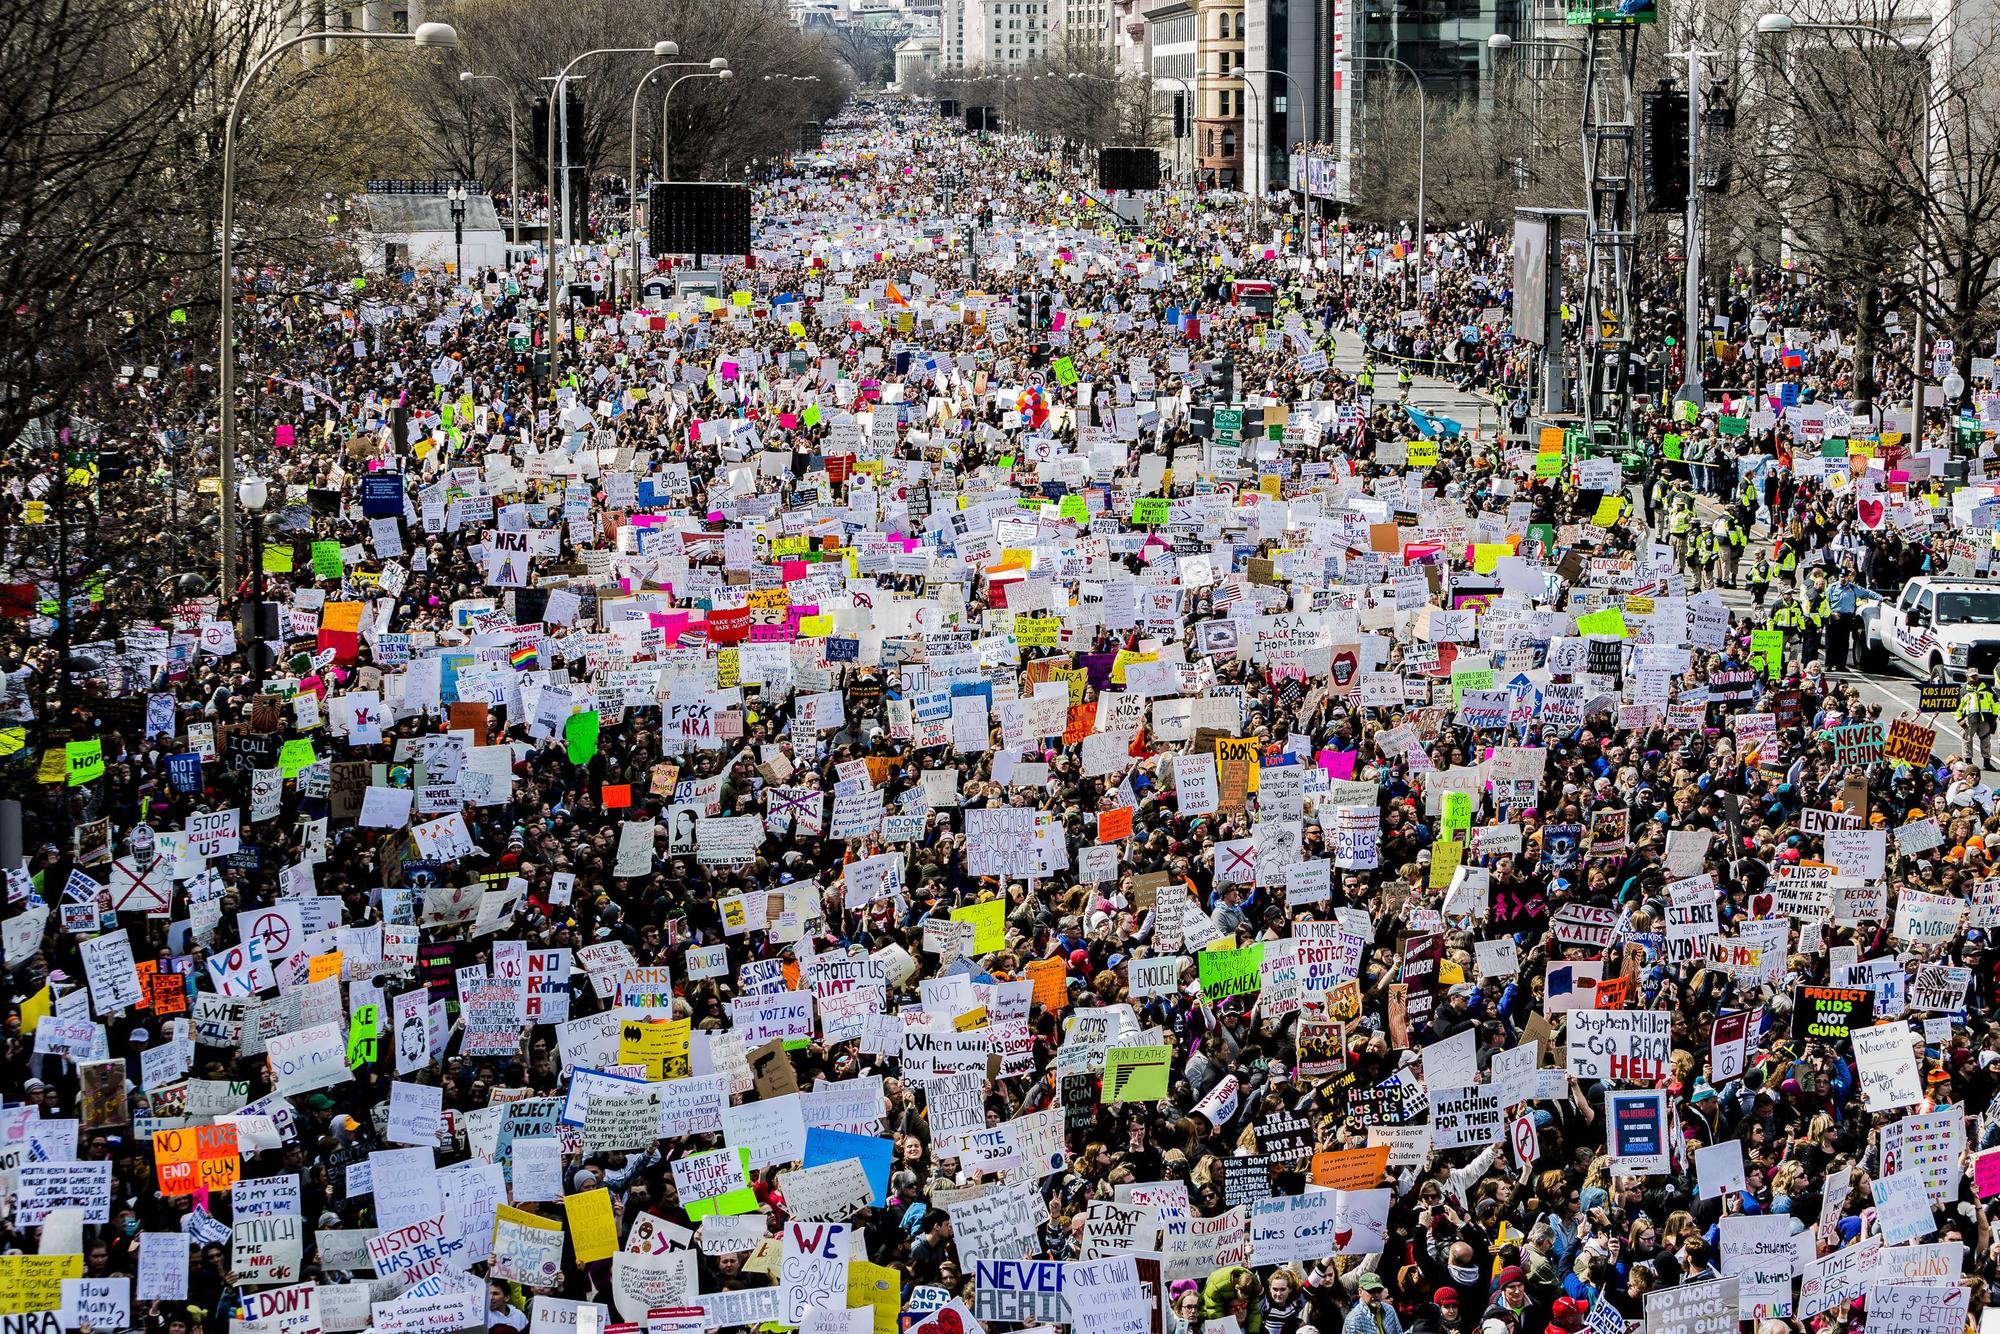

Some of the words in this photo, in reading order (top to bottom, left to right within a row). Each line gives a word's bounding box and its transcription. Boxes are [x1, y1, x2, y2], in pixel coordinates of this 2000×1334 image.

[875, 421, 893, 429] GUN
[872, 429, 895, 437] REFORM
[661, 477, 688, 488] GUNS
[671, 486, 688, 495] HUGS
[495, 532, 527, 552] NRA
[965, 550, 991, 563] GUNS
[293, 613, 316, 623] NEVER
[730, 620, 748, 629] AGAIN
[1274, 618, 1286, 627] AS
[1296, 616, 1304, 626] A
[292, 623, 315, 633] AGAIN
[1445, 622, 1458, 635] BS
[1259, 630, 1289, 640] BLACK
[1897, 627, 1919, 648] POLICE
[829, 639, 856, 649] NEVER
[979, 639, 1005, 653] NEVER
[1262, 641, 1287, 649] HOPE
[1405, 645, 1415, 653] WE
[1416, 643, 1437, 652] KNOW
[830, 649, 854, 659] AGAIN
[1923, 687, 1938, 695] KIDS
[1939, 686, 1958, 695] LIVES
[916, 696, 931, 705] END
[932, 693, 948, 703] GUN
[1922, 696, 1956, 707] MATTER
[918, 705, 949, 718] VIOLENCE
[1462, 707, 1502, 716] FUTURE
[1543, 703, 1582, 714] ASSAULT
[1465, 716, 1506, 726] VOTERS
[1544, 713, 1582, 724] WEAPON
[682, 718, 709, 736] NRA
[922, 724, 944, 732] KIDS
[1889, 720, 1936, 747] BROKEN
[921, 735, 948, 746] GUNS
[1836, 726, 1882, 745] NEVER
[242, 740, 268, 753] CALL
[1219, 741, 1259, 761] BOOKS
[1839, 745, 1883, 765] AGAIN
[170, 761, 194, 772] NOT
[236, 755, 254, 770] BS
[172, 773, 194, 783] ONE
[656, 768, 676, 778] books
[426, 790, 450, 798] NEVER
[433, 798, 458, 806] AGAIN
[192, 813, 231, 832] STOP
[901, 818, 922, 826] ONE
[1805, 812, 1860, 831] ENOUGH
[188, 828, 229, 842] KILLING
[1338, 833, 1375, 850] Policy
[200, 843, 219, 856] US
[1542, 863, 1557, 871] NOT
[1559, 862, 1576, 870] GUNS
[65, 905, 96, 916] PROTECT
[1669, 905, 1713, 925] SILENCE
[64, 921, 95, 929] STUDENTS
[1298, 946, 1343, 963] PROTECT
[1710, 943, 1726, 963] NO
[689, 953, 725, 970] ENOUGH
[1405, 959, 1433, 975] LOUDER!
[817, 960, 867, 980] PROTECT
[870, 959, 884, 978] US
[1272, 968, 1296, 983] LAWS
[1309, 963, 1332, 976] OUR
[624, 969, 668, 984] ARMS
[1138, 966, 1174, 988] ENOUGH
[624, 993, 668, 1008] HUGGING
[1804, 988, 1866, 1000] PROTECT
[1916, 988, 1962, 1010] TRUMP
[1408, 998, 1432, 1014] HIGHER
[1816, 1000, 1851, 1012] KIDS
[1817, 1013, 1847, 1024] NOT
[1808, 1024, 1849, 1037] GUNS
[906, 1034, 951, 1052] When
[957, 1037, 984, 1051] will
[1004, 1035, 1032, 1054] BLOOD
[1631, 1038, 1669, 1060] BACK
[1859, 1039, 1903, 1052] November
[1112, 1050, 1131, 1060] GUN
[1133, 1049, 1166, 1060] DEATHS
[904, 1058, 929, 1070] our
[932, 1058, 956, 1072] lives
[958, 1061, 985, 1072] come
[1609, 1055, 1666, 1078] HELL
[1064, 1076, 1086, 1086] END
[1879, 1080, 1893, 1092] NOT
[1069, 1086, 1092, 1099] GUN
[1348, 1085, 1401, 1103] History
[1890, 1090, 1914, 1102] Bullets
[1347, 1103, 1369, 1114] has
[1379, 1101, 1396, 1112] its
[1910, 1122, 1929, 1131] YOUR
[1934, 1120, 1951, 1128] LIFE
[974, 1132, 1004, 1147] VOTE
[1376, 1128, 1391, 1138] Your
[1394, 1128, 1423, 1137] Silence
[1457, 1128, 1491, 1142] LIVES
[157, 1130, 182, 1152] NO
[1266, 1139, 1288, 1152] NOT
[1295, 1137, 1304, 1146] A
[984, 1145, 1012, 1158] 2020
[162, 1164, 191, 1178] END
[202, 1158, 234, 1175] GUN
[678, 1163, 693, 1173] WE
[696, 1160, 711, 1169] ARE
[713, 1153, 731, 1163] THE
[688, 1165, 728, 1183] FUTURE
[699, 1186, 728, 1198] DEAD
[1254, 1199, 1286, 1216] How
[1291, 1195, 1327, 1211] Much
[1253, 1227, 1285, 1240] Lives
[1294, 1219, 1334, 1237] Cost?
[1755, 1242, 1791, 1254] Students
[250, 1255, 272, 1266] NRA
[1819, 1253, 1855, 1274] TIME
[1904, 1256, 1949, 1277] GUNS
[1075, 1267, 1100, 1286] ONE
[1104, 1262, 1128, 1283] Child
[1755, 1272, 1789, 1284] Victims
[80, 1283, 109, 1298] How
[1824, 1277, 1849, 1293] FOR
[1805, 1280, 1866, 1316] CHANGE
[78, 1301, 108, 1314] Many
[1919, 1305, 1961, 1323] BETTER
